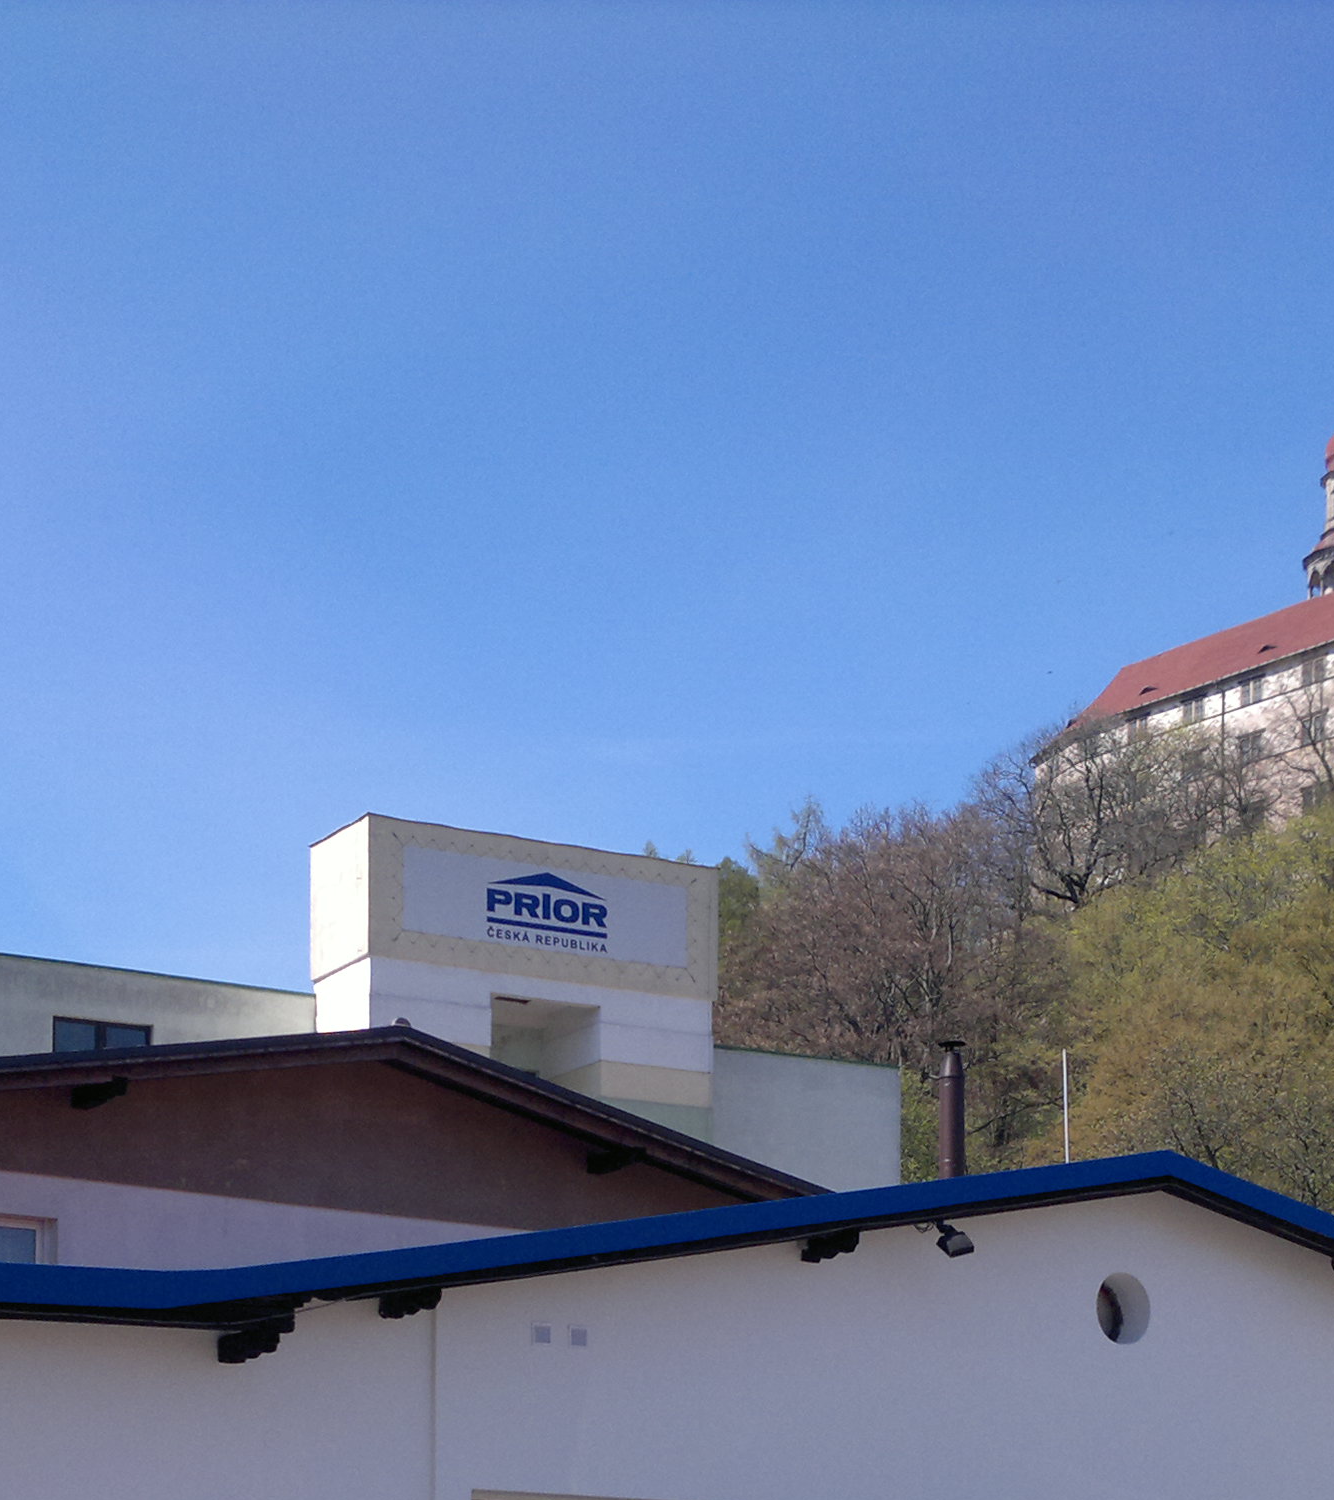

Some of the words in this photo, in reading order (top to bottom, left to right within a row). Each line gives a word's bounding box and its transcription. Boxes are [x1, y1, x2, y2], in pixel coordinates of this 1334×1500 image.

[486, 888, 608, 928] PRIOR
[487, 926, 530, 943] ČESKÁ
[535, 934, 608, 953] REPUBLIKA
